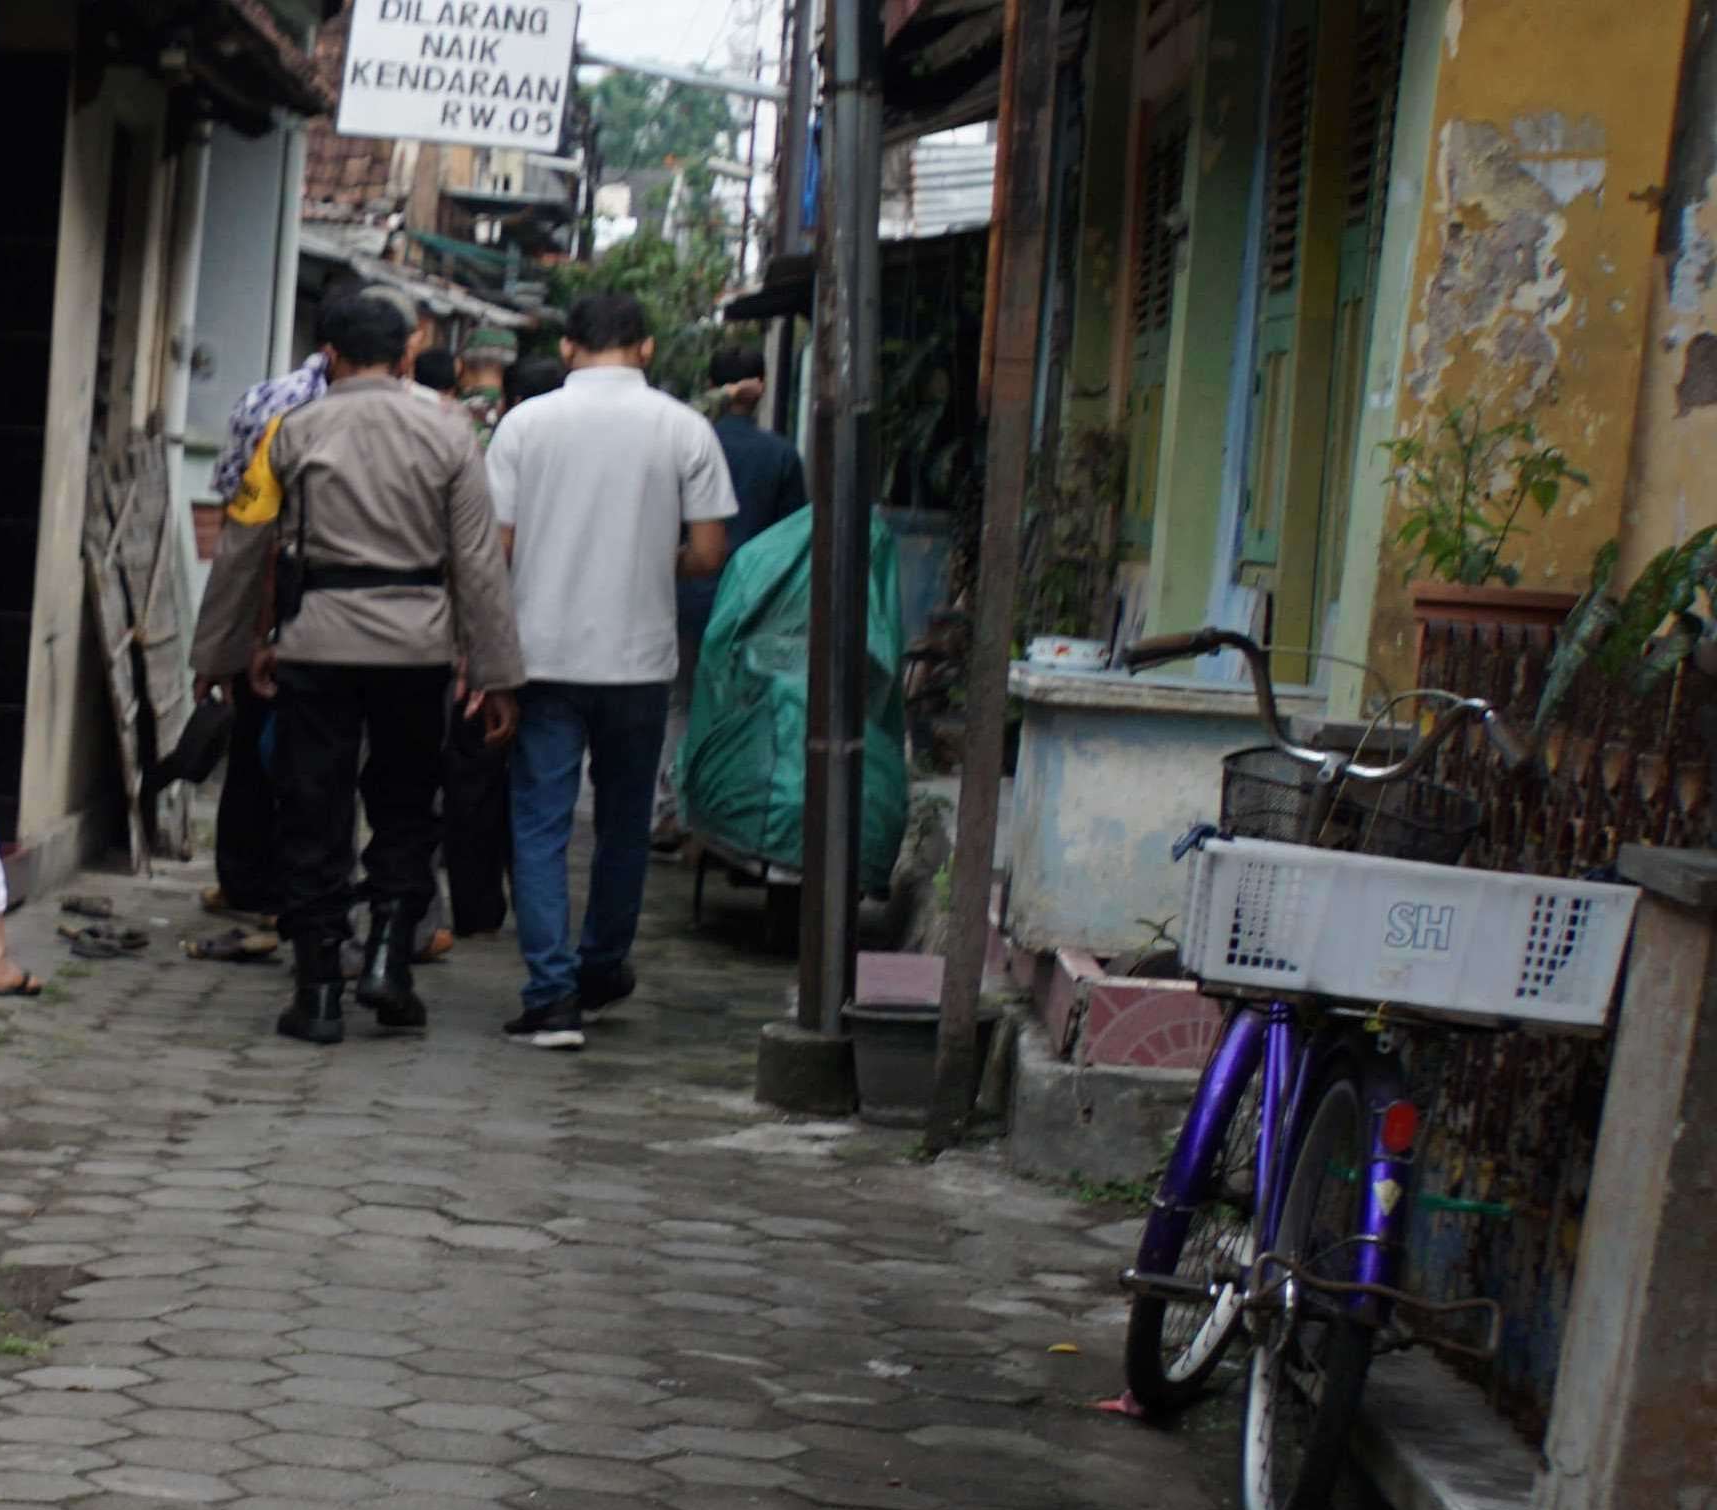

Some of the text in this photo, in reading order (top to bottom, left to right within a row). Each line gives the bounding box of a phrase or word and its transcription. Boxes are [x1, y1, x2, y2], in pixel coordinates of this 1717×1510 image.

[378, 0, 549, 36] DILARANG
[420, 32, 502, 65] NAIK
[350, 59, 561, 104] KENDARAAN
[1383, 901, 1456, 951] SH
